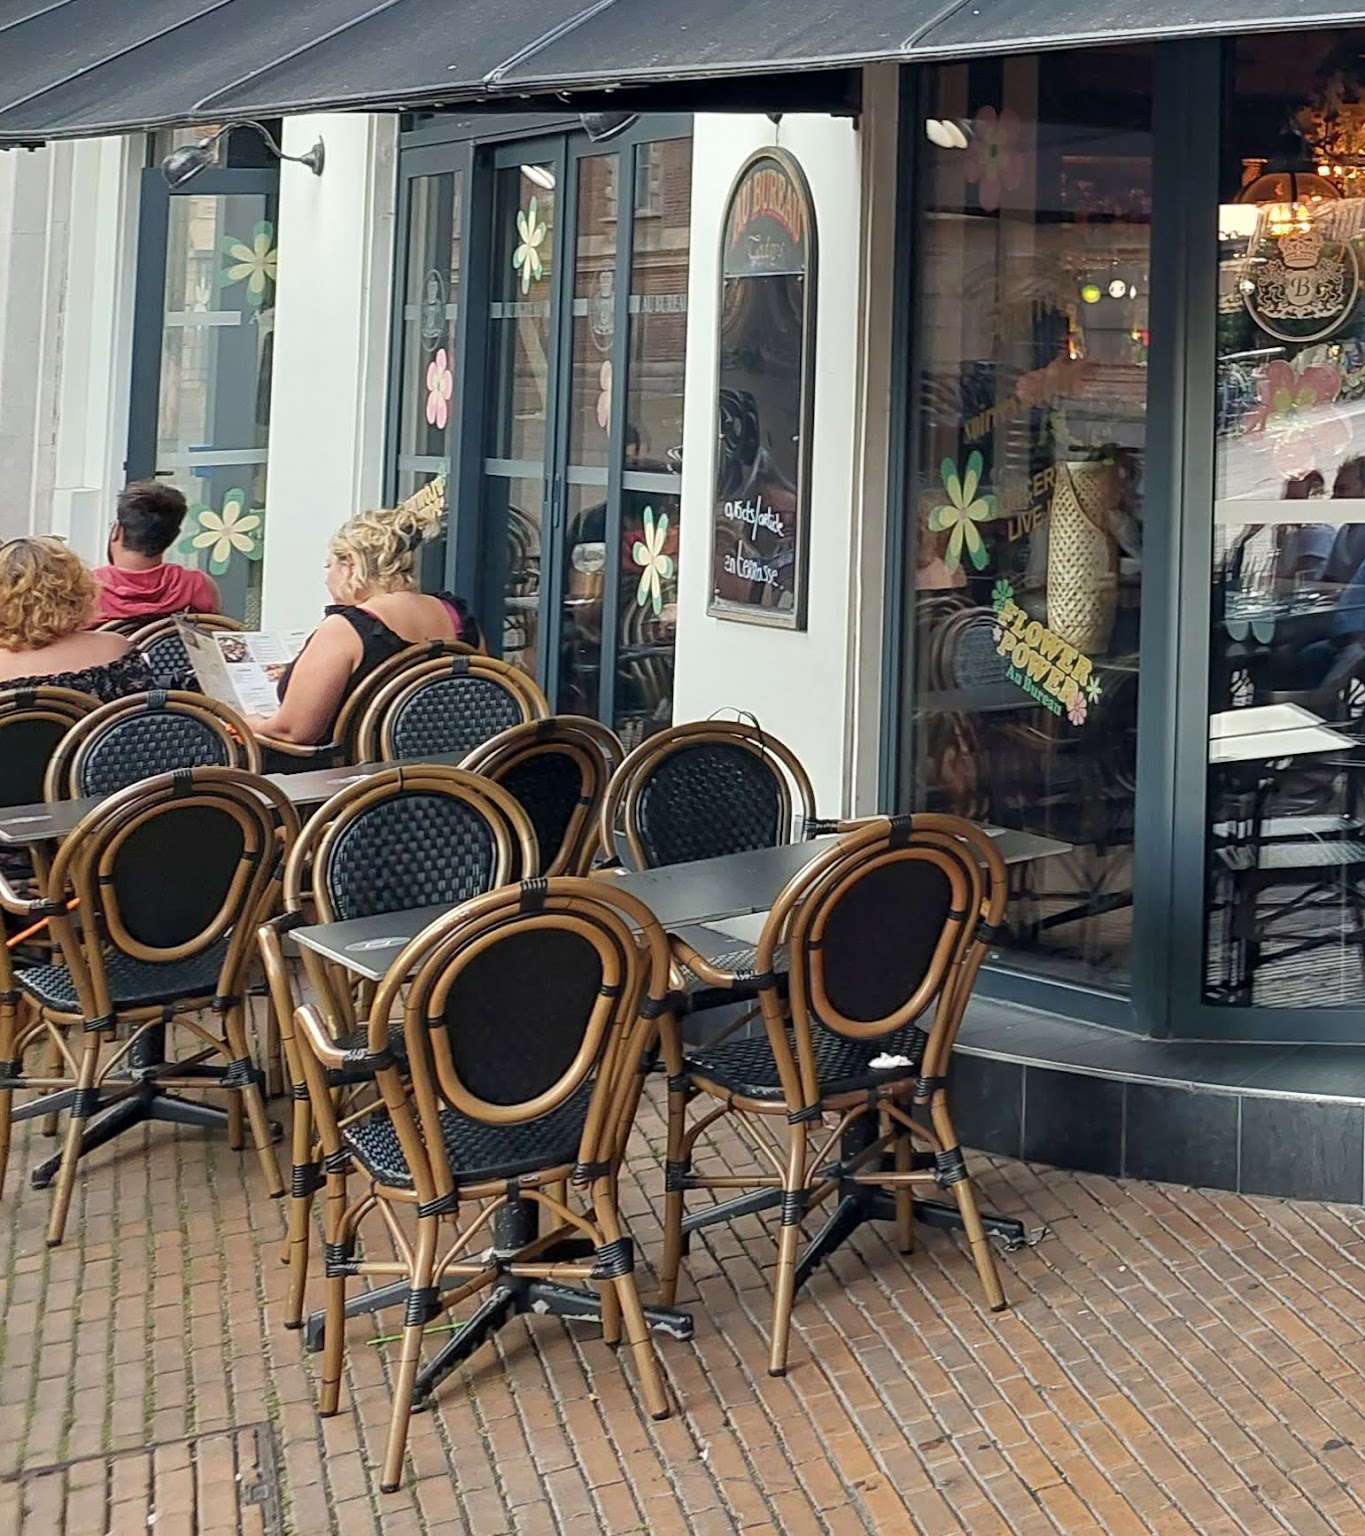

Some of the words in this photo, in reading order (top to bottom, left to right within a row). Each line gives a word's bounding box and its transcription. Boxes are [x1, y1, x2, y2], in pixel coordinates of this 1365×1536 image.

[996, 600, 1093, 687] FLOWER
[996, 630, 1080, 712] POWER
[1022, 676, 1063, 716] Bureau
